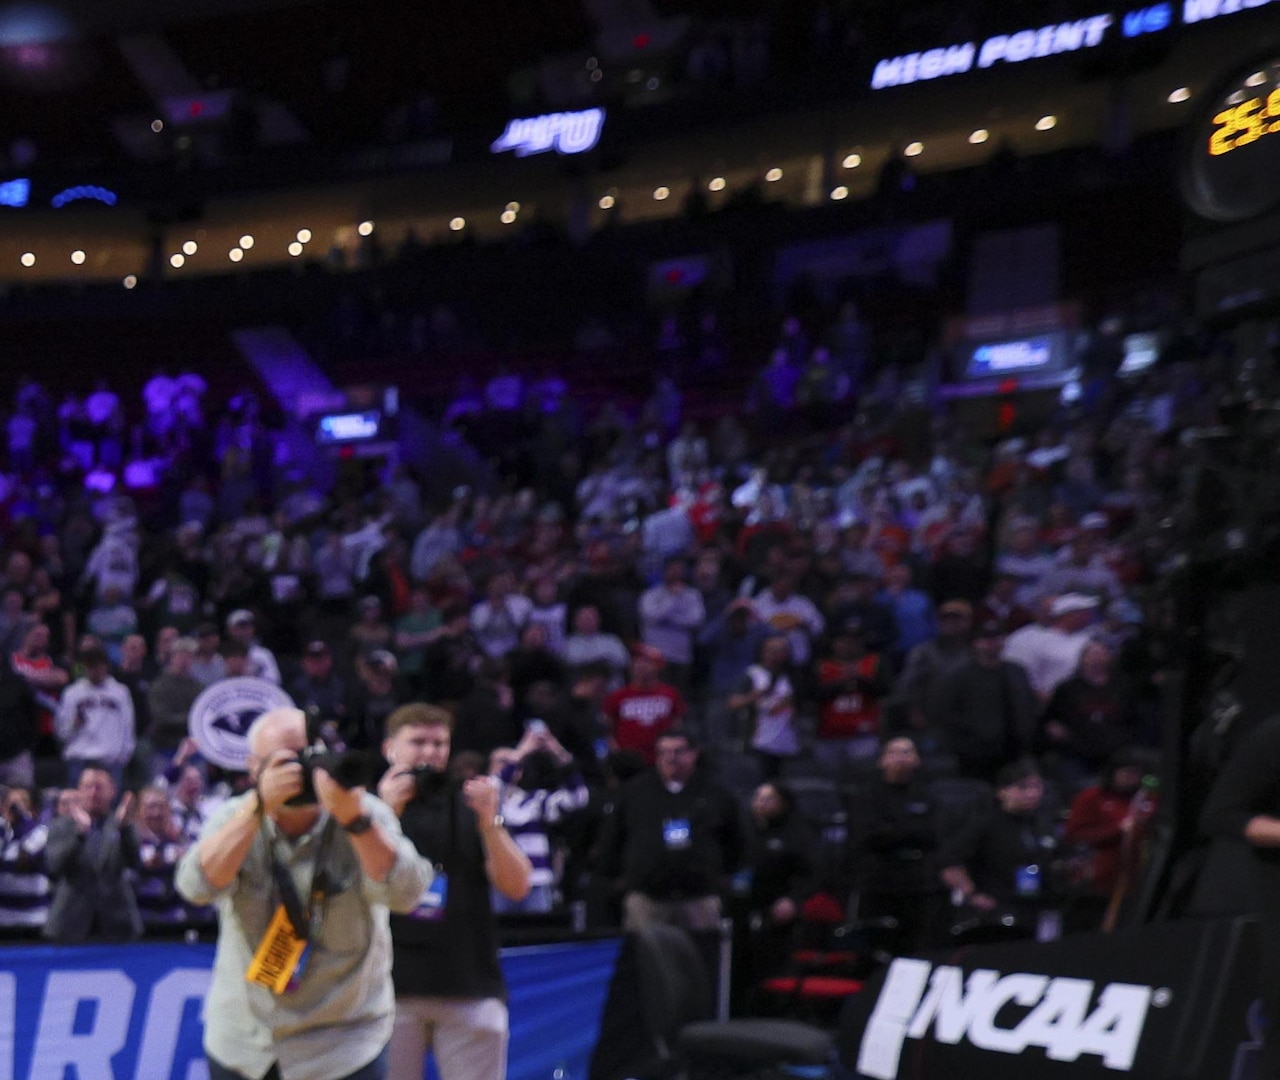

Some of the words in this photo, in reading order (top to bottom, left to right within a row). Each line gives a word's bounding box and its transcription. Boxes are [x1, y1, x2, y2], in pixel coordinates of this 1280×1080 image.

[870, 41, 976, 90] HIGH
[977, 13, 1112, 69] POINT
[907, 964, 1152, 1071] NCAA
